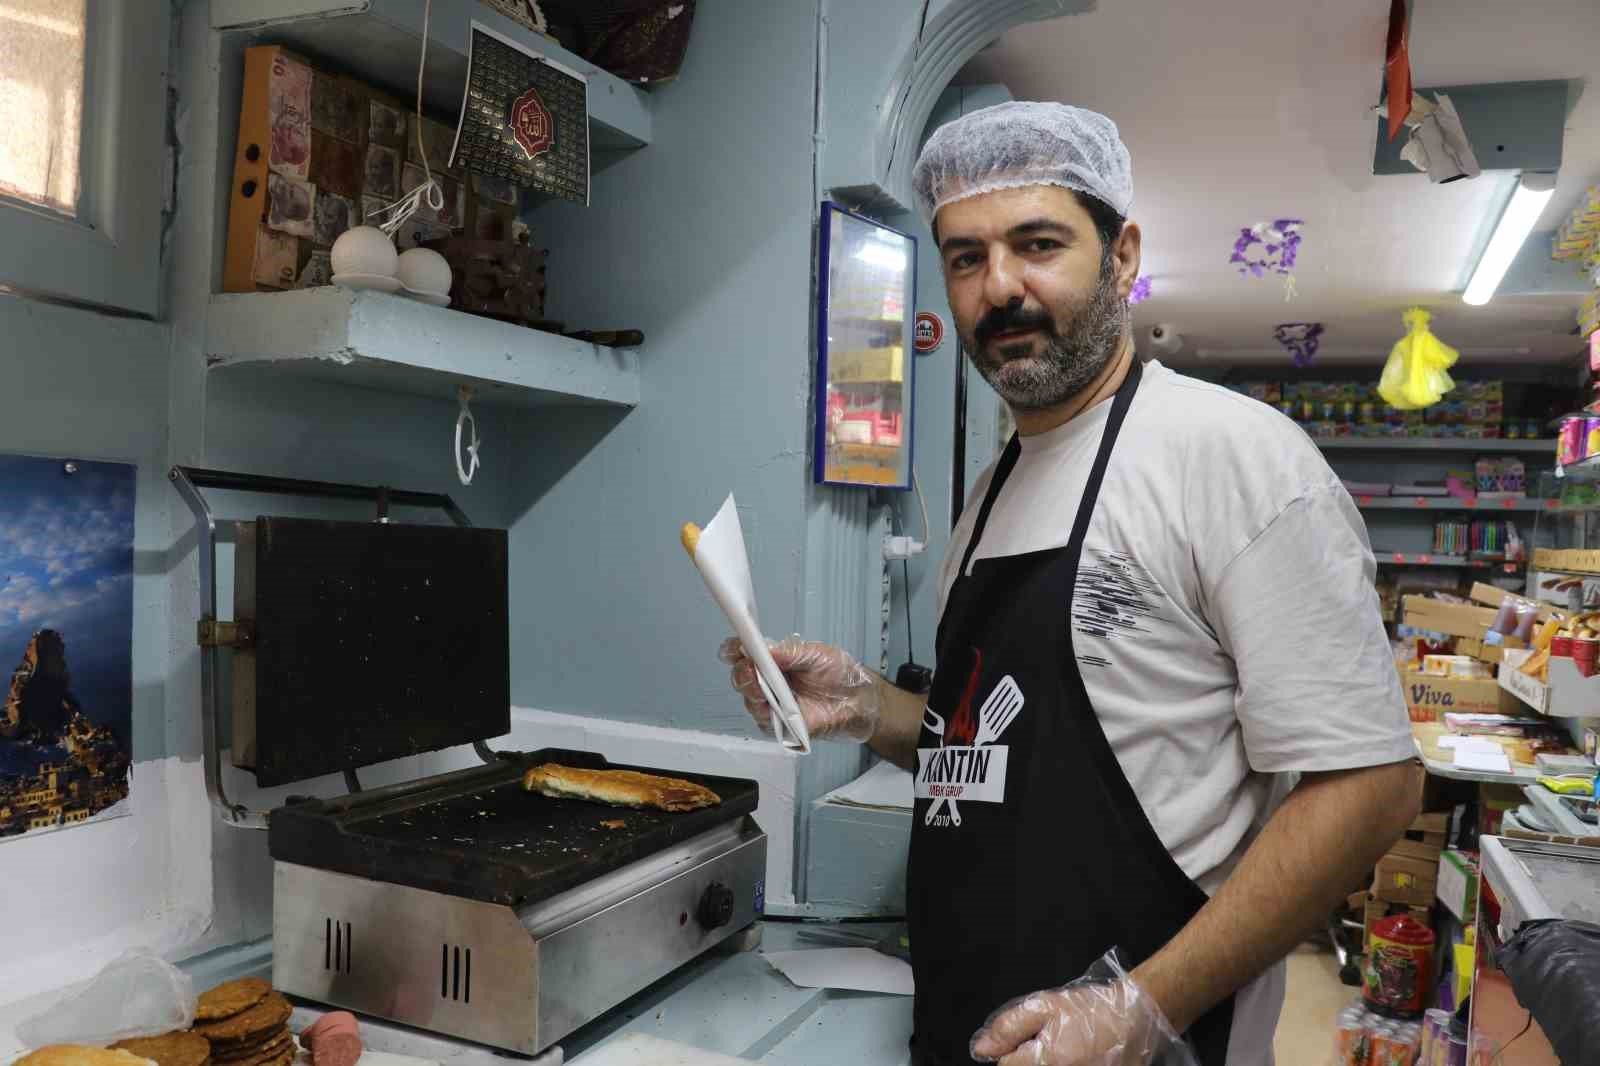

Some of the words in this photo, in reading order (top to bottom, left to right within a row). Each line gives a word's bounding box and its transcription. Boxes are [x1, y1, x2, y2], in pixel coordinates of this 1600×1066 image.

[1410, 683, 1453, 705] Viva
[928, 785, 946, 797] MBK
[945, 786, 964, 798] GRUP
[933, 815, 950, 827] 2010
